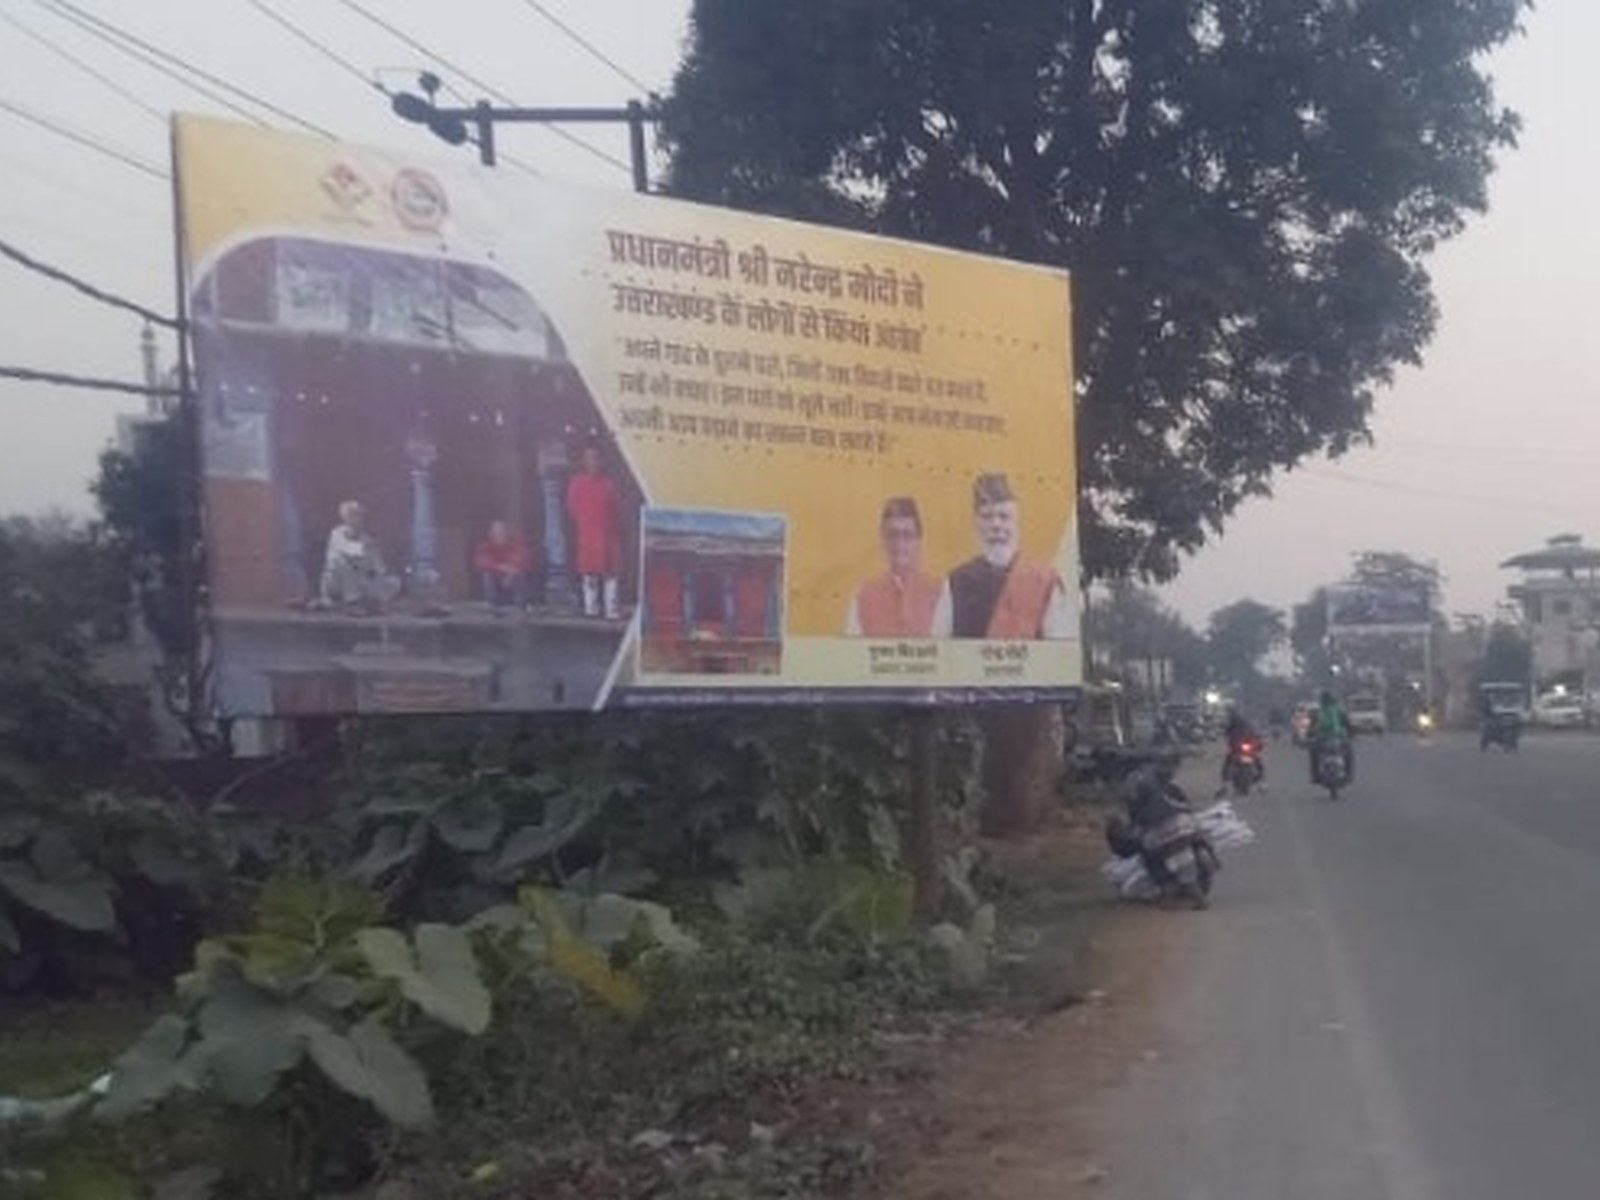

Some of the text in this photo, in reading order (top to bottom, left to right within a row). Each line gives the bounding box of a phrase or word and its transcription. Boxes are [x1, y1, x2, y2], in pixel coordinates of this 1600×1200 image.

[606, 229, 925, 310] प्रधानमंत्री श्री नरेन्द्र मोदी ने
[721, 292, 742, 327] के
[746, 298, 795, 336] लोगों
[799, 305, 821, 341] से
